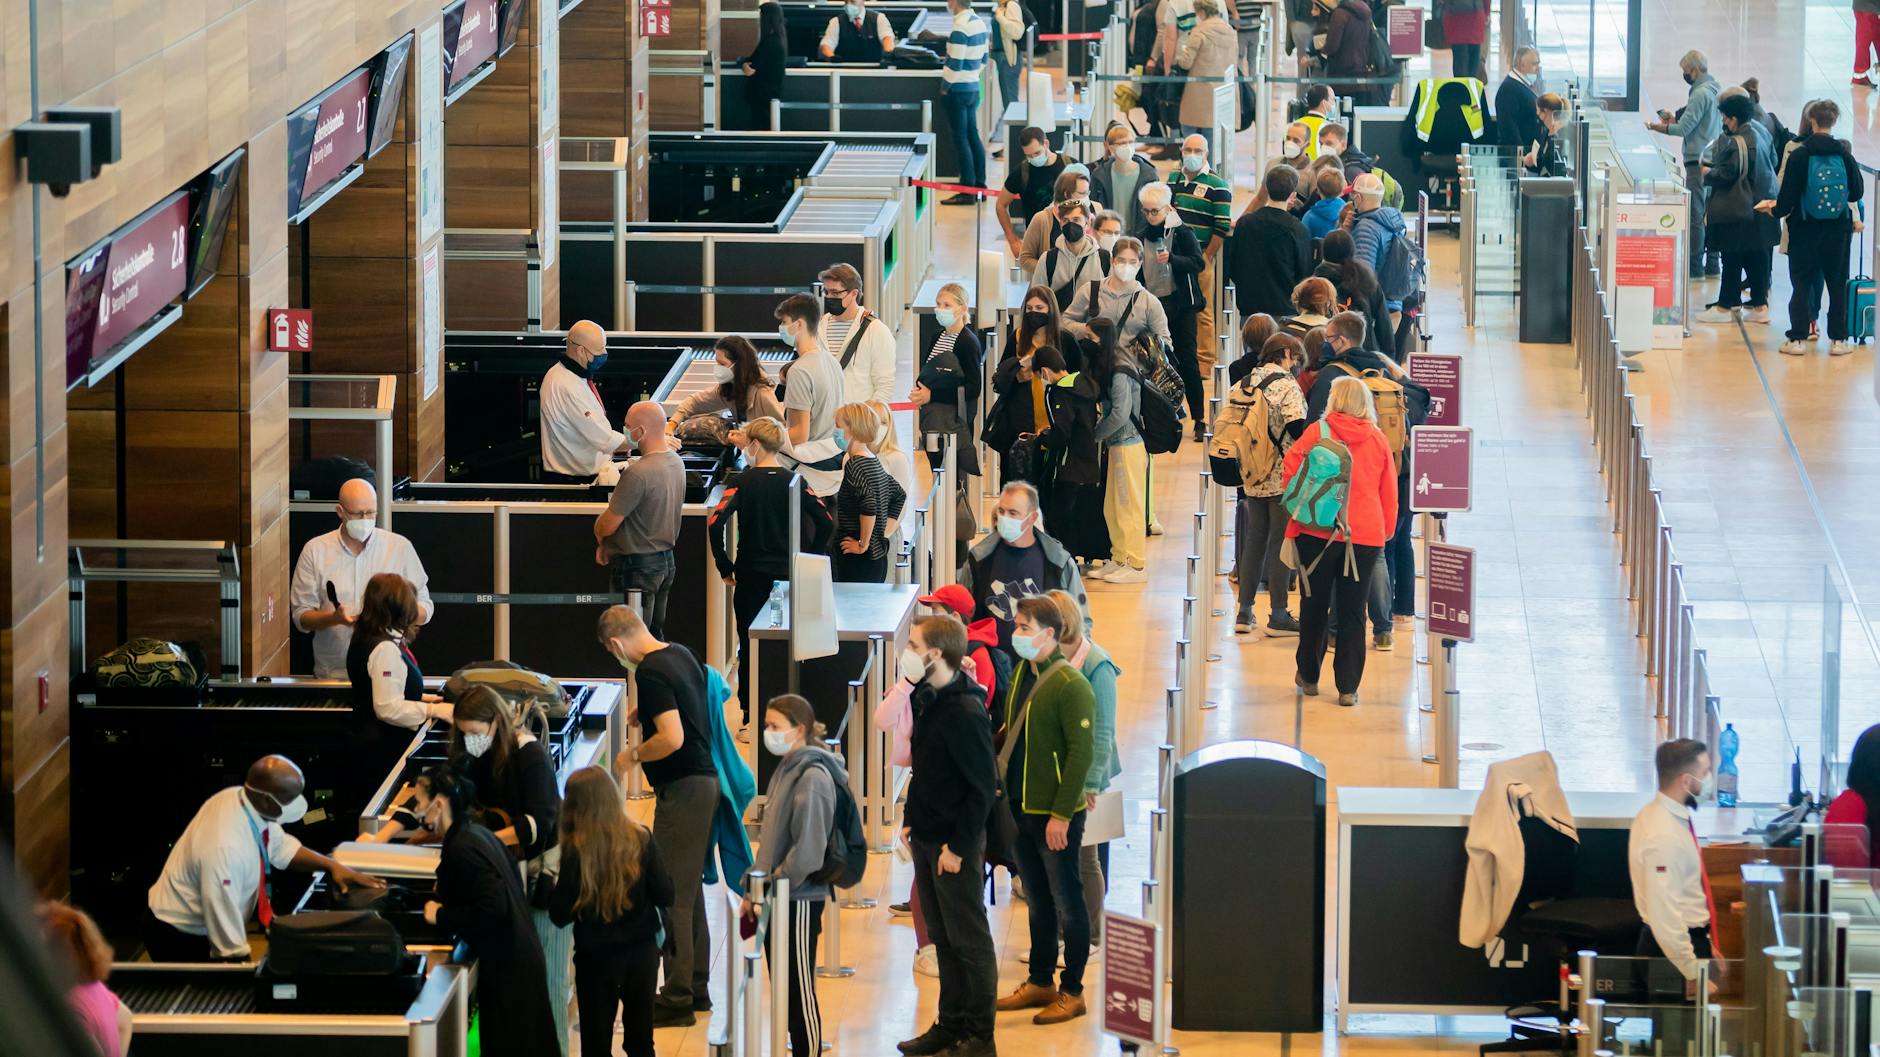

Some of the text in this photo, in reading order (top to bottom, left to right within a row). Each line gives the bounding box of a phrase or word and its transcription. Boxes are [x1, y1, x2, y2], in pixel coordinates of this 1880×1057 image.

[356, 96, 367, 134] 2.7
[171, 225, 185, 270] 2.8
[112, 242, 155, 291] Sicherheitskontrolle
[111, 279, 139, 314] Security Control
[476, 594, 493, 603] BER
[576, 595, 592, 603] BER
[1595, 979, 1614, 992] ER
